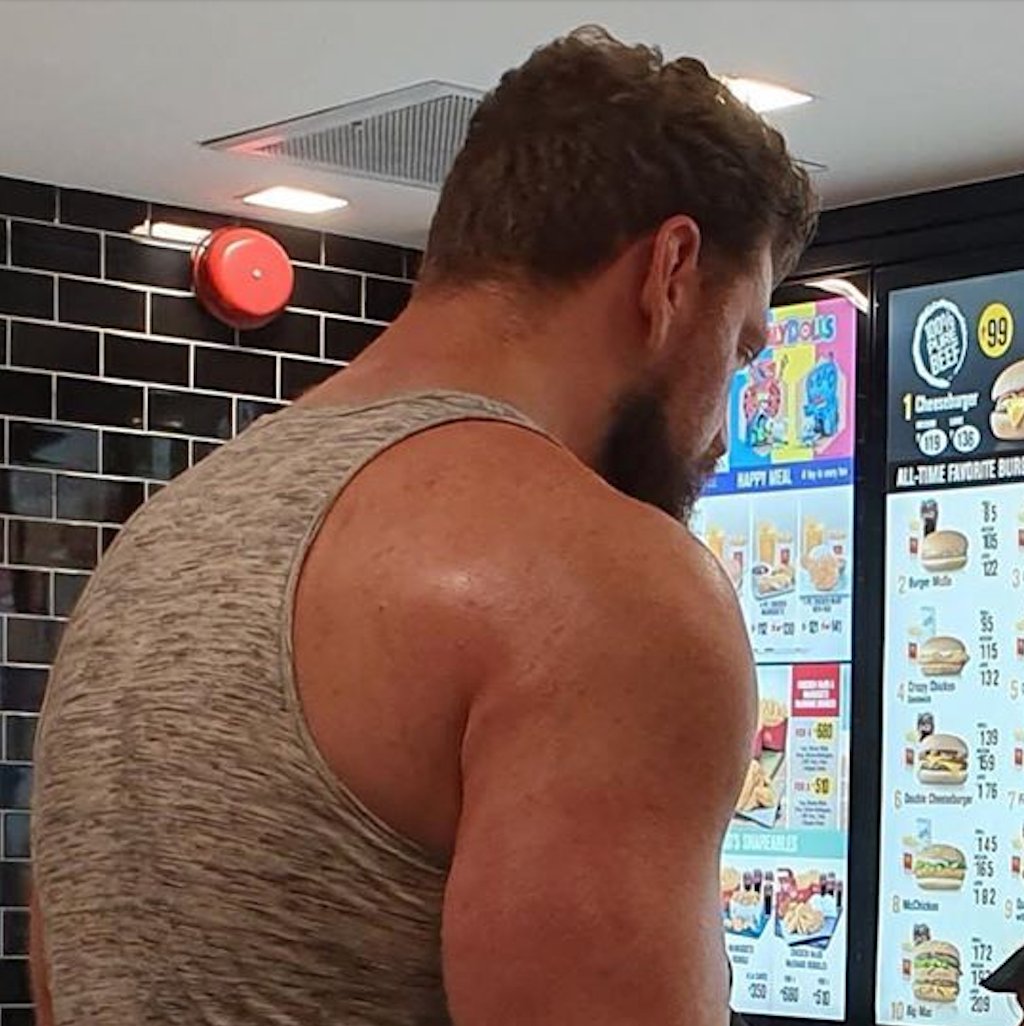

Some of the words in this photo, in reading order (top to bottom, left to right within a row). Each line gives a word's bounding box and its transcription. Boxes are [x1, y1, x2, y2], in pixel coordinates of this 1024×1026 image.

[903, 393, 911, 421] 1
[916, 392, 979, 413] Cheeseburger
[896, 465, 946, 487] ALL-TIME
[949, 459, 996, 482] FAVORITE
